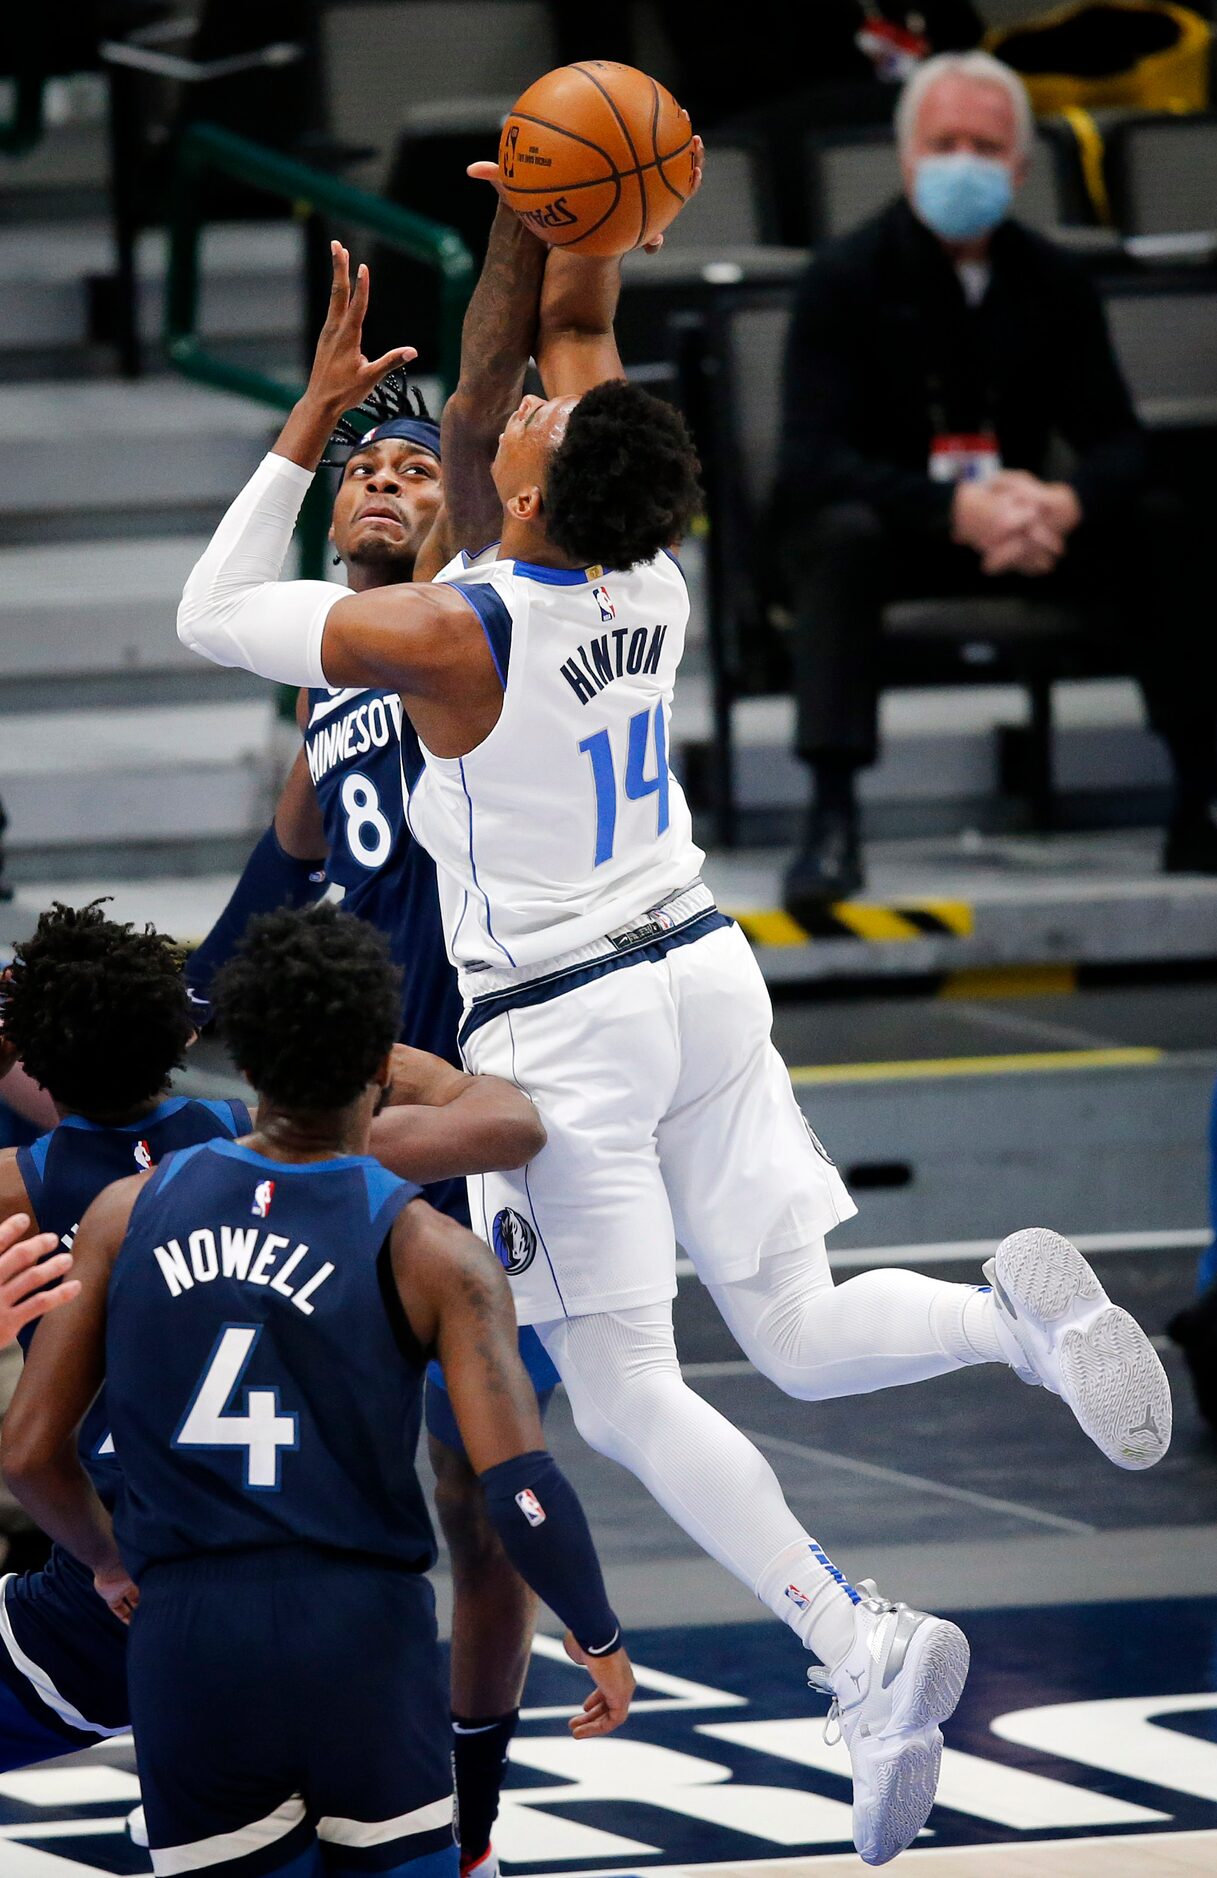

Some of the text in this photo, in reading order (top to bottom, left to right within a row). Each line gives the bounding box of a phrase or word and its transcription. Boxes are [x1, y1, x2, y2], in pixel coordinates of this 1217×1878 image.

[560, 625, 668, 706] HINTON
[305, 693, 402, 786] MINNESOT
[577, 696, 671, 870] 14
[341, 773, 392, 868] 8
[153, 1226, 335, 1316] NOWELL
[171, 1322, 300, 1492] 4
